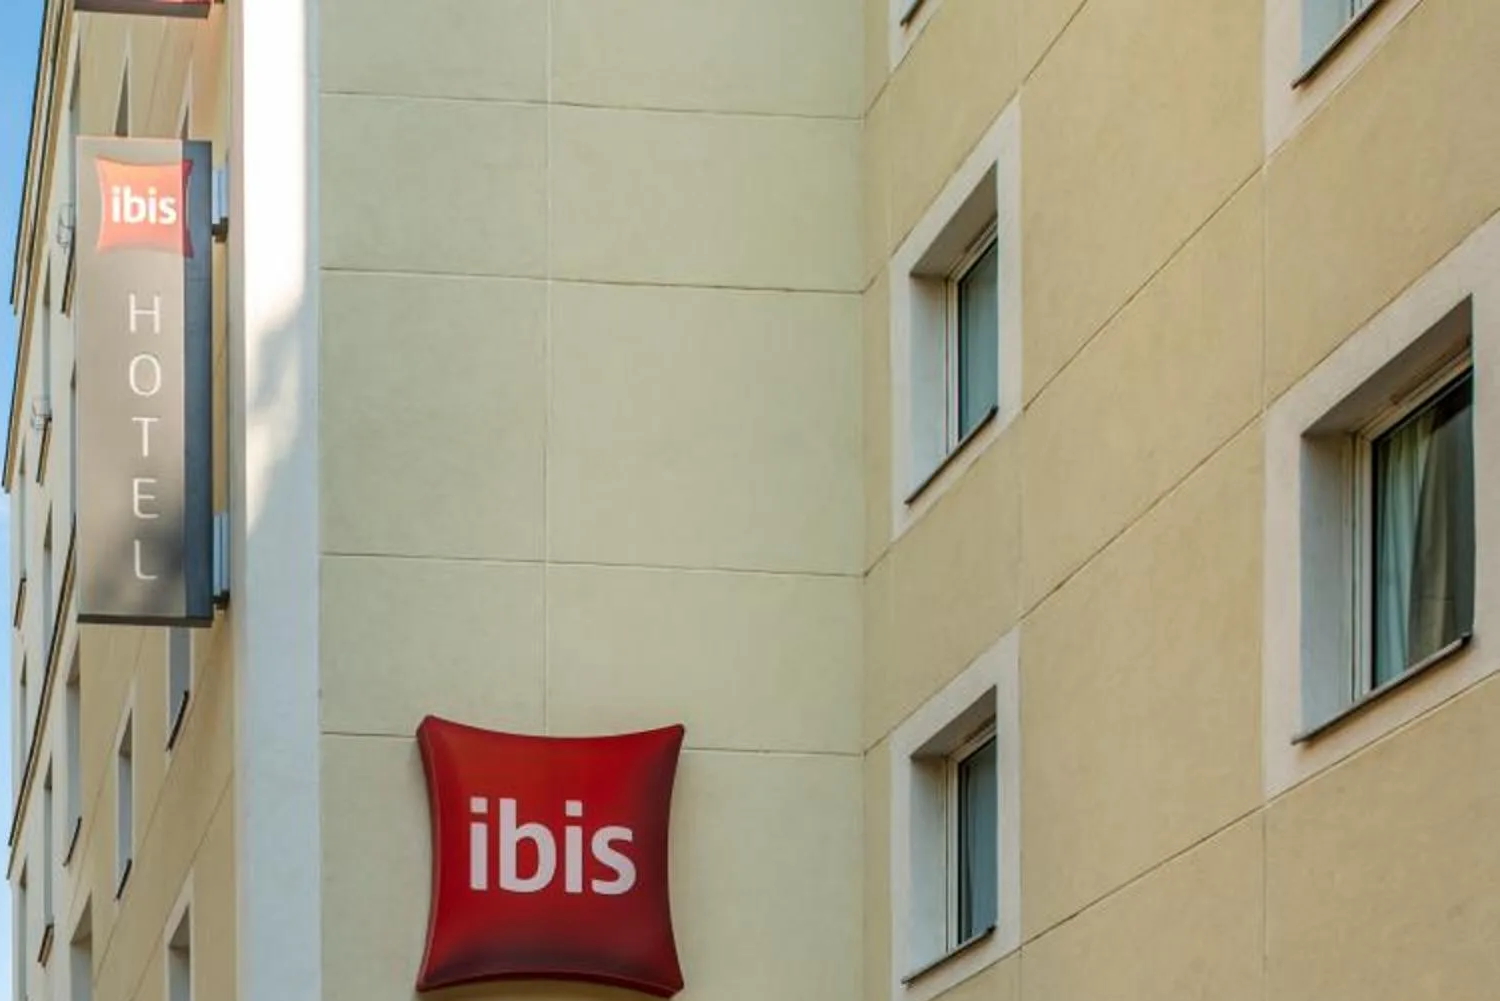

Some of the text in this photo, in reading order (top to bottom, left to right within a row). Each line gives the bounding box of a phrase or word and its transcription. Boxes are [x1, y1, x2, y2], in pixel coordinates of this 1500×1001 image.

[111, 184, 178, 225] ibis
[128, 292, 162, 581] HOTEL
[469, 796, 637, 895] ibis
